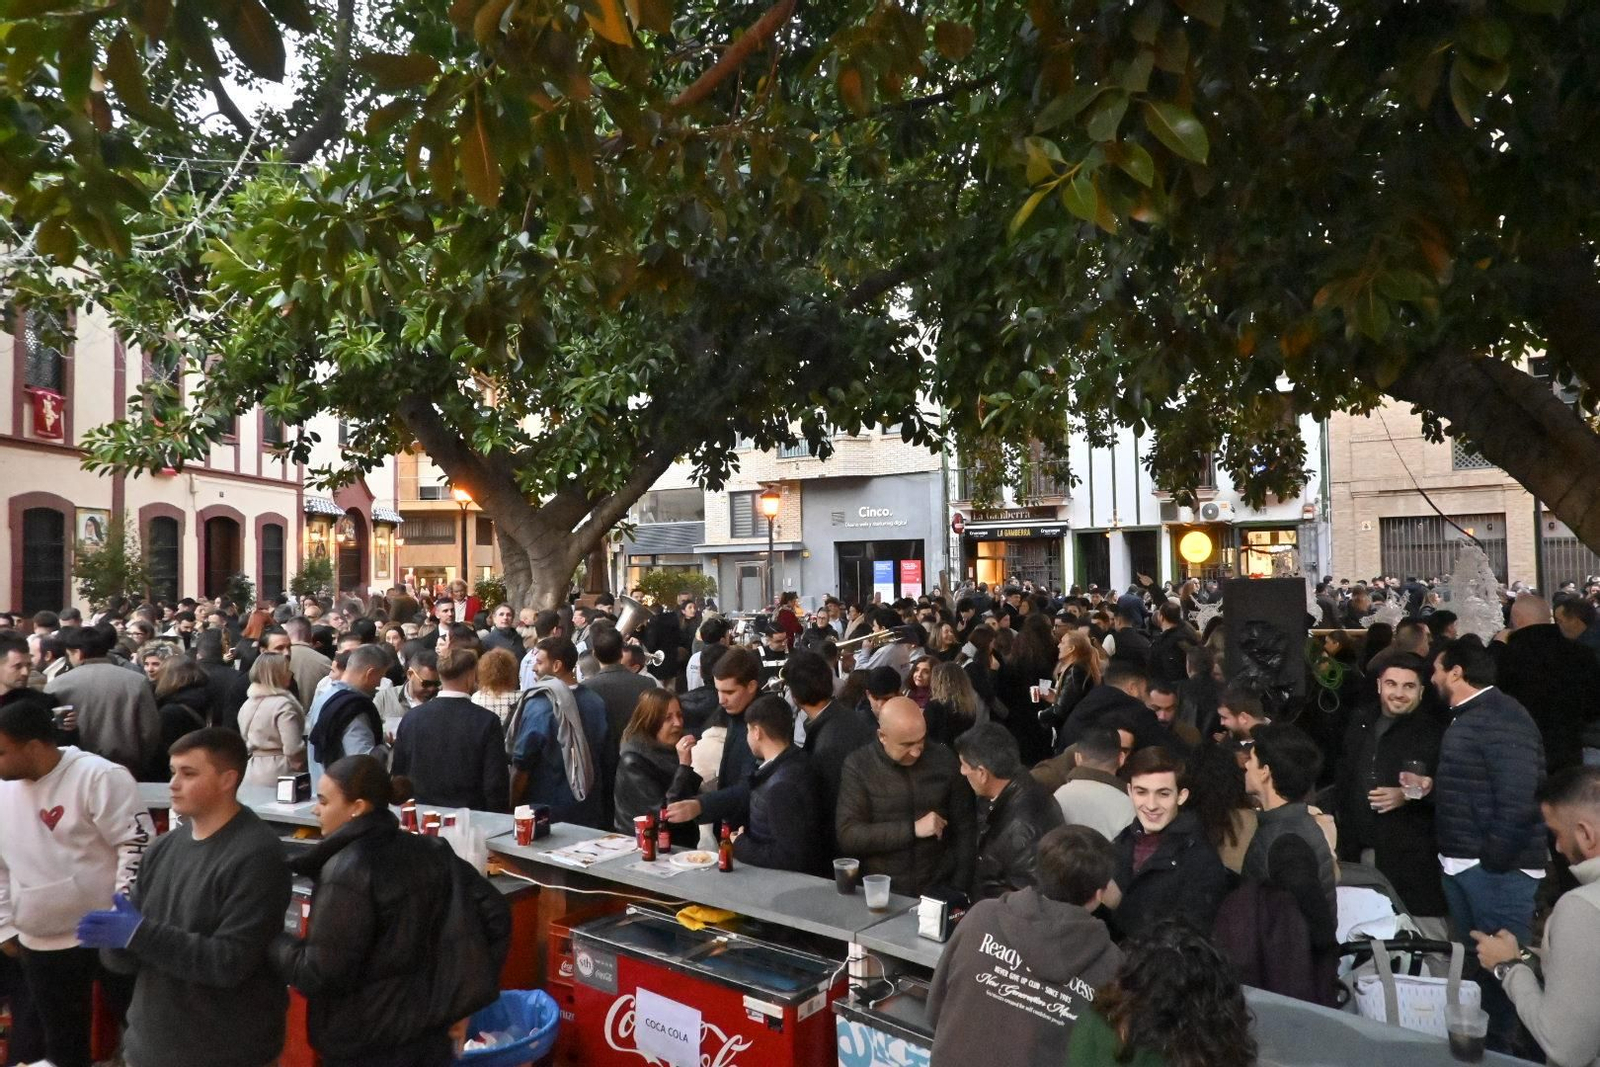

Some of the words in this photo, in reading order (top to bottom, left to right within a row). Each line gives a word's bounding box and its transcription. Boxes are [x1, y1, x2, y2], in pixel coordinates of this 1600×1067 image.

[859, 506, 893, 518] Cinco.
[997, 529, 1004, 537] LA
[1004, 528, 1031, 537] GAMBERRA
[979, 933, 1023, 971] Ready
[994, 965, 1009, 978] NEVER
[1009, 972, 1021, 982] GIVE
[1020, 976, 1028, 985] UP
[645, 1017, 667, 1034] COCA
[667, 1027, 689, 1043] COLA
